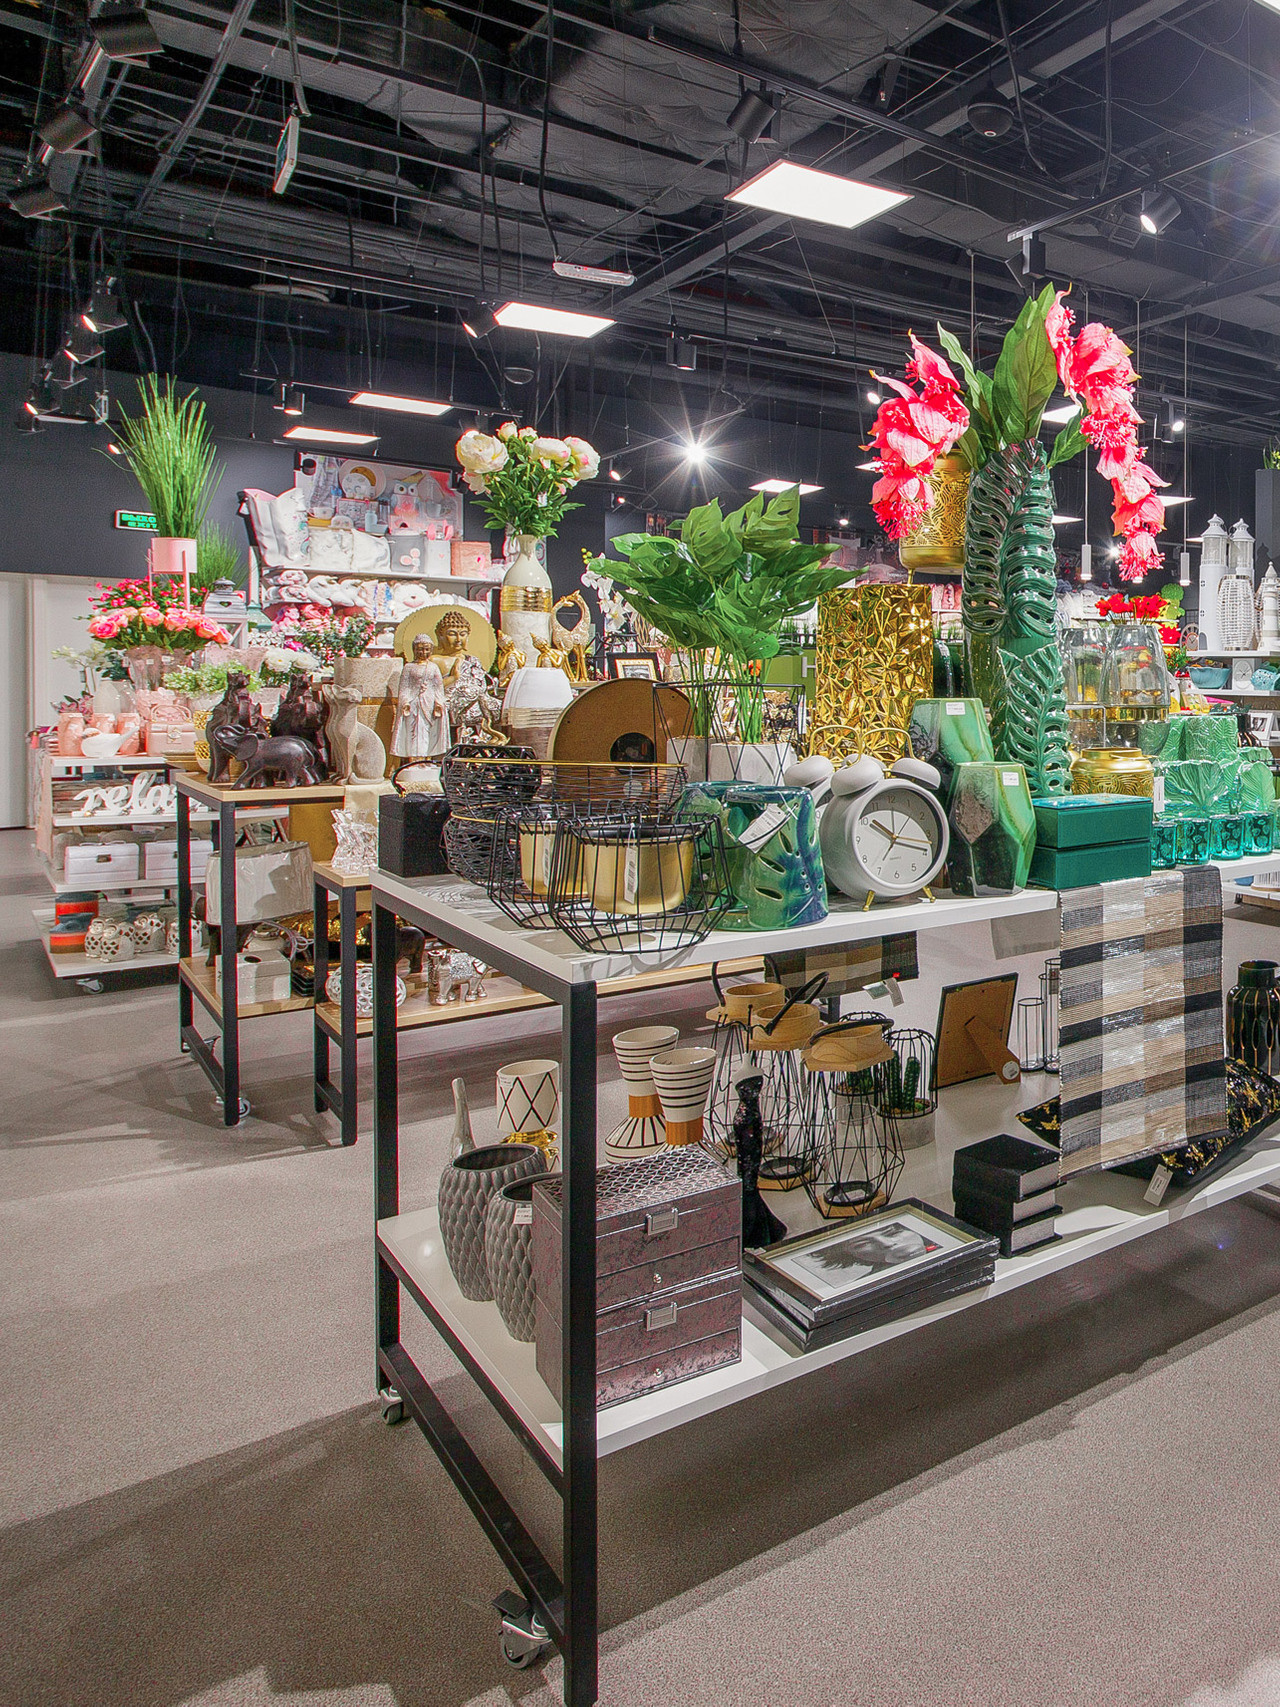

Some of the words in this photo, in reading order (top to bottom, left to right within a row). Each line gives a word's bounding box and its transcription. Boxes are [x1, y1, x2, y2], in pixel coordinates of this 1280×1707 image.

[121, 513, 157, 523] ВЫХО
[128, 521, 158, 529] EXIT
[887, 796, 896, 804] 12
[906, 799, 911, 807] 1
[871, 802, 879, 810] 11
[919, 811, 925, 820] 2
[860, 817, 869, 826] 10
[926, 829, 931, 838] 3
[855, 835, 861, 844] 9
[862, 854, 868, 863] 8
[876, 866, 882, 875] 7
[911, 862, 917, 872] 5
[894, 869, 900, 879] 6
